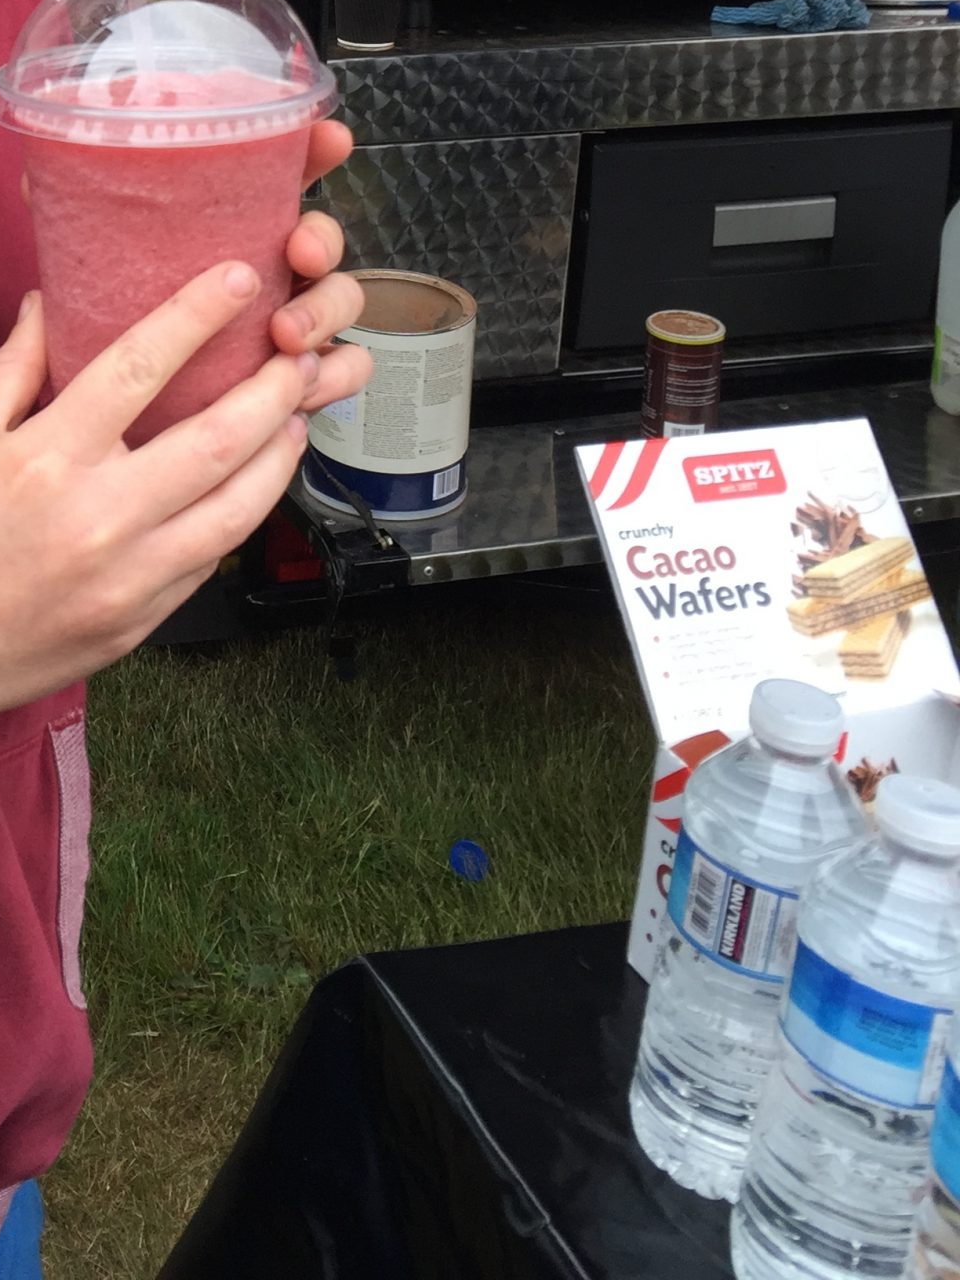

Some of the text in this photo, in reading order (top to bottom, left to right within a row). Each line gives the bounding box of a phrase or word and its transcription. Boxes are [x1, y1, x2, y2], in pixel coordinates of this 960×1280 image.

[693, 460, 776, 486] SPITZ
[618, 523, 674, 540] crunchy
[626, 545, 737, 580] Cacao
[635, 577, 772, 620] Wafers
[720, 883, 746, 957] KIRKLAND
